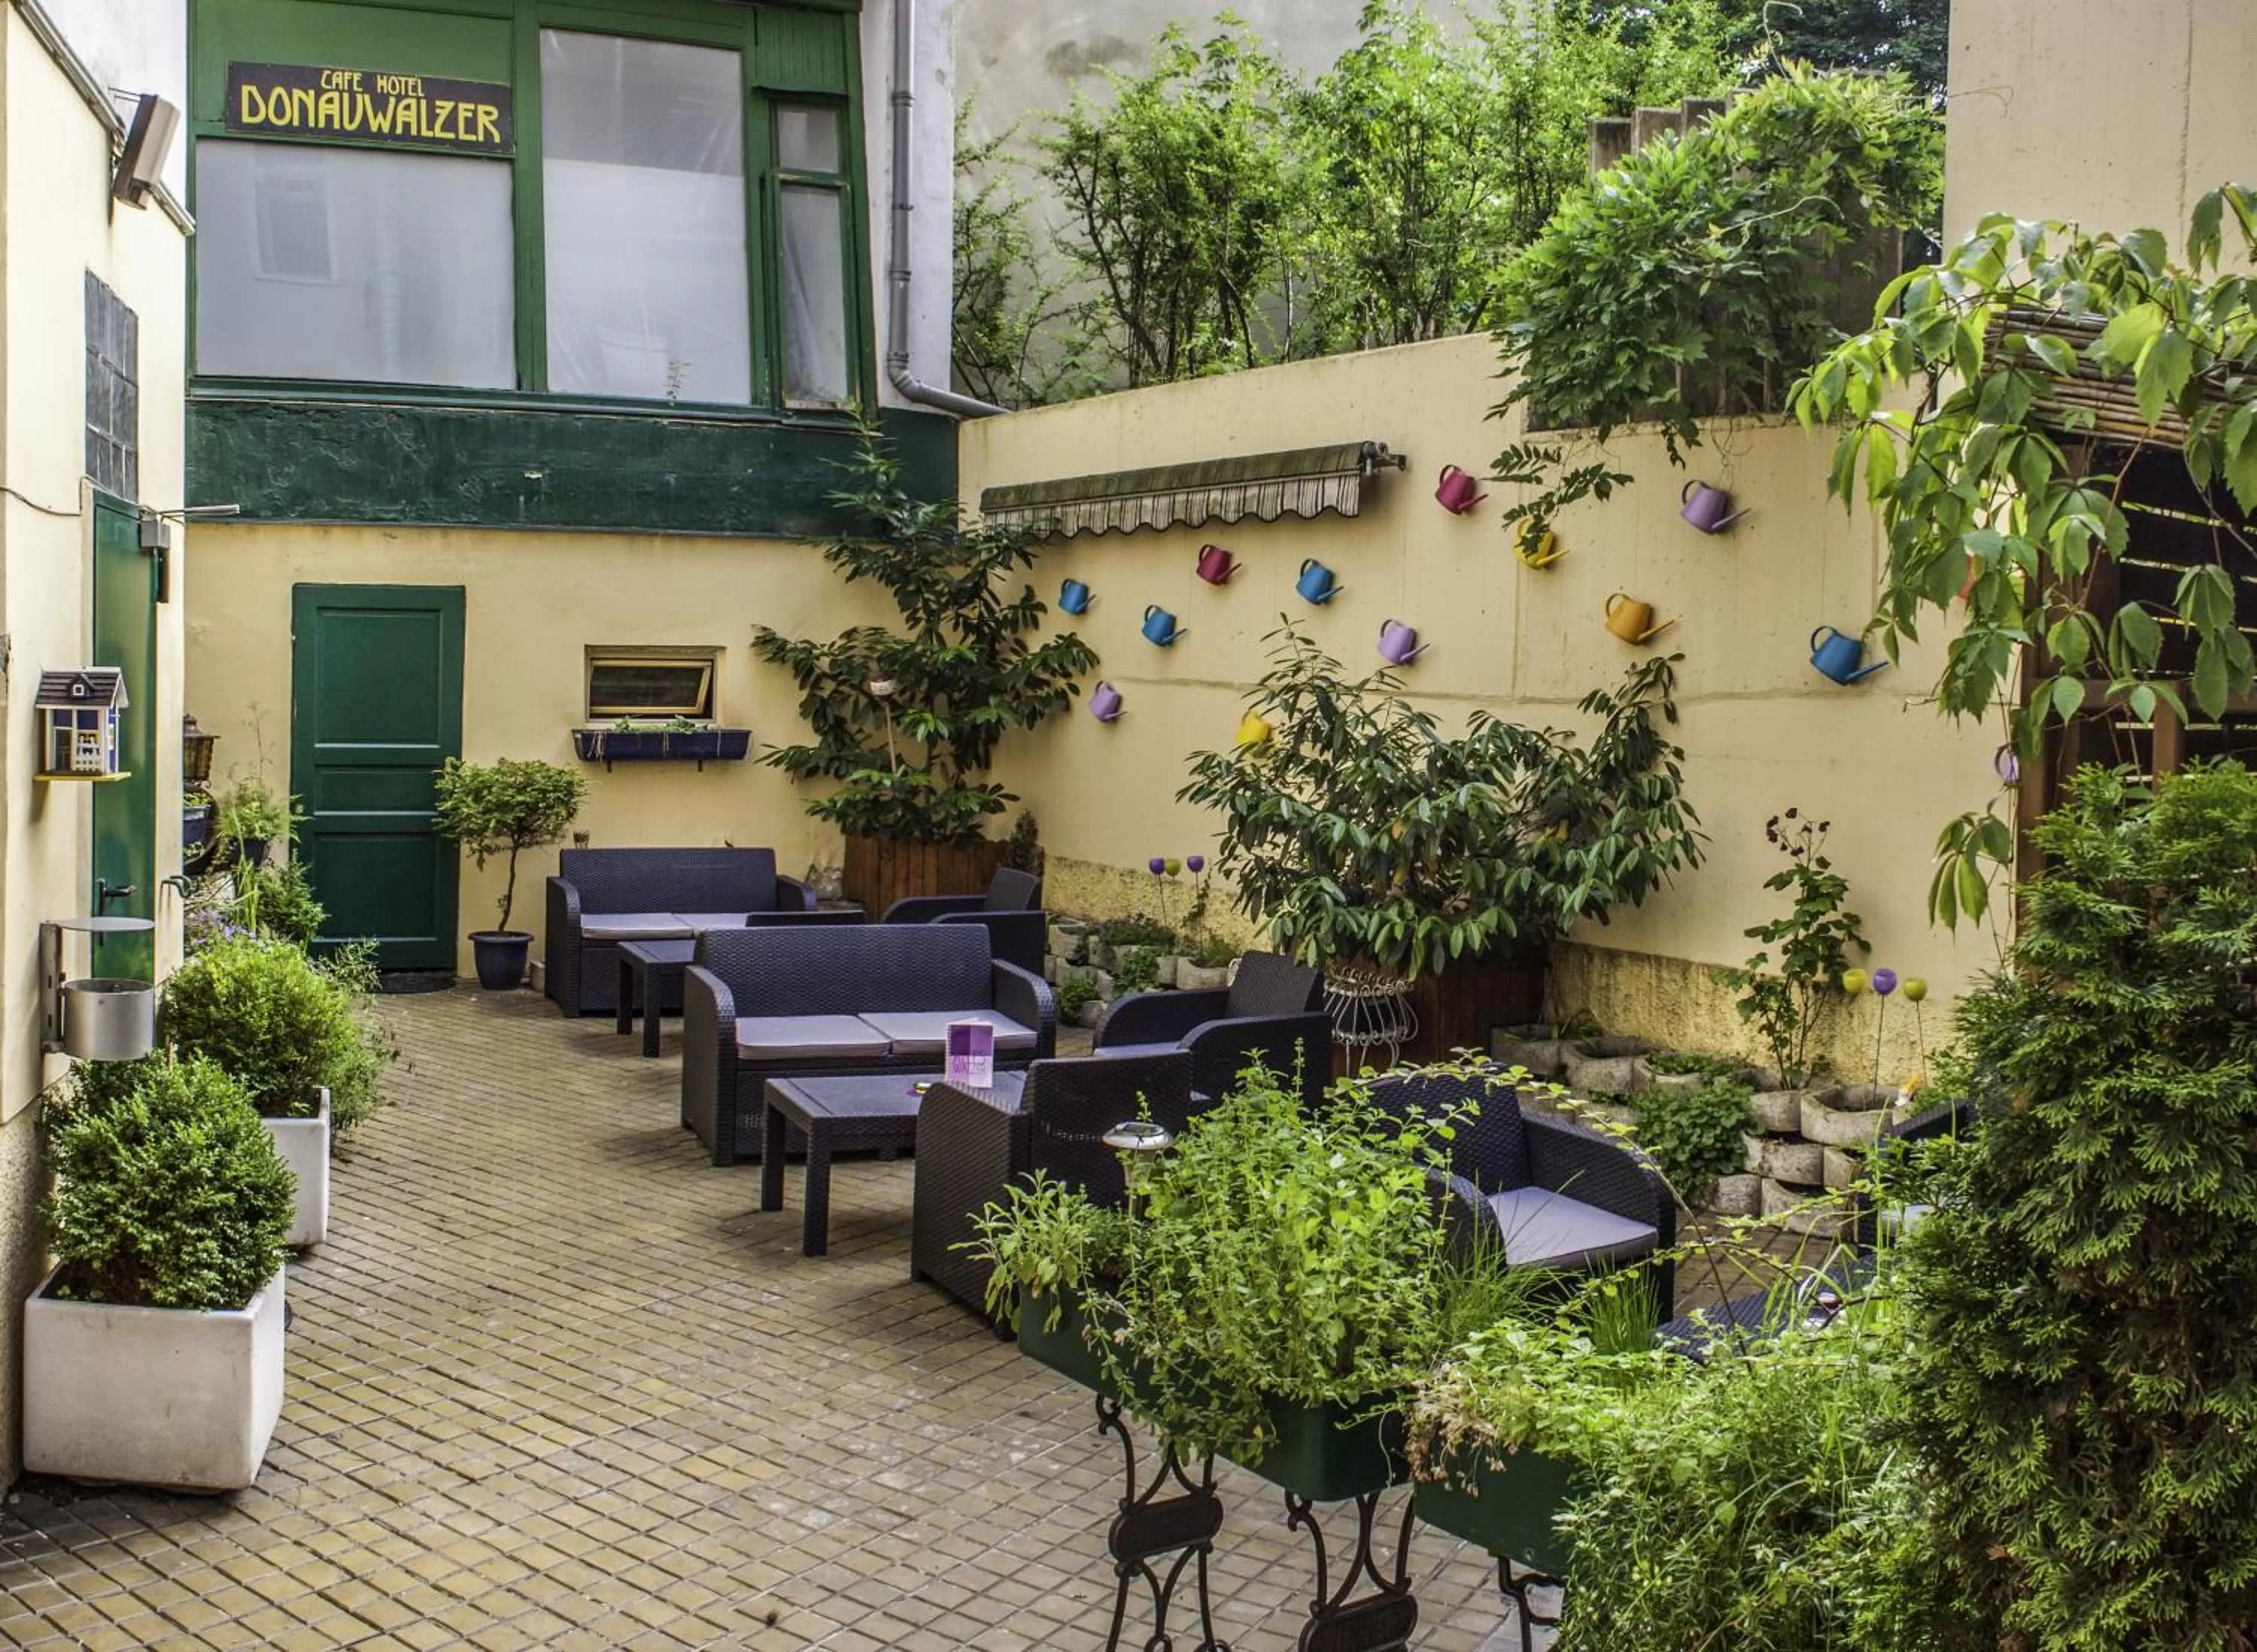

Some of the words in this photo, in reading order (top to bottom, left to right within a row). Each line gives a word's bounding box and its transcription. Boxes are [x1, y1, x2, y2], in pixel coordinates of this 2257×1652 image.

[320, 69, 363, 93] CAFE
[377, 74, 425, 96] HOTEL
[241, 84, 501, 143] DONAUWALZER
